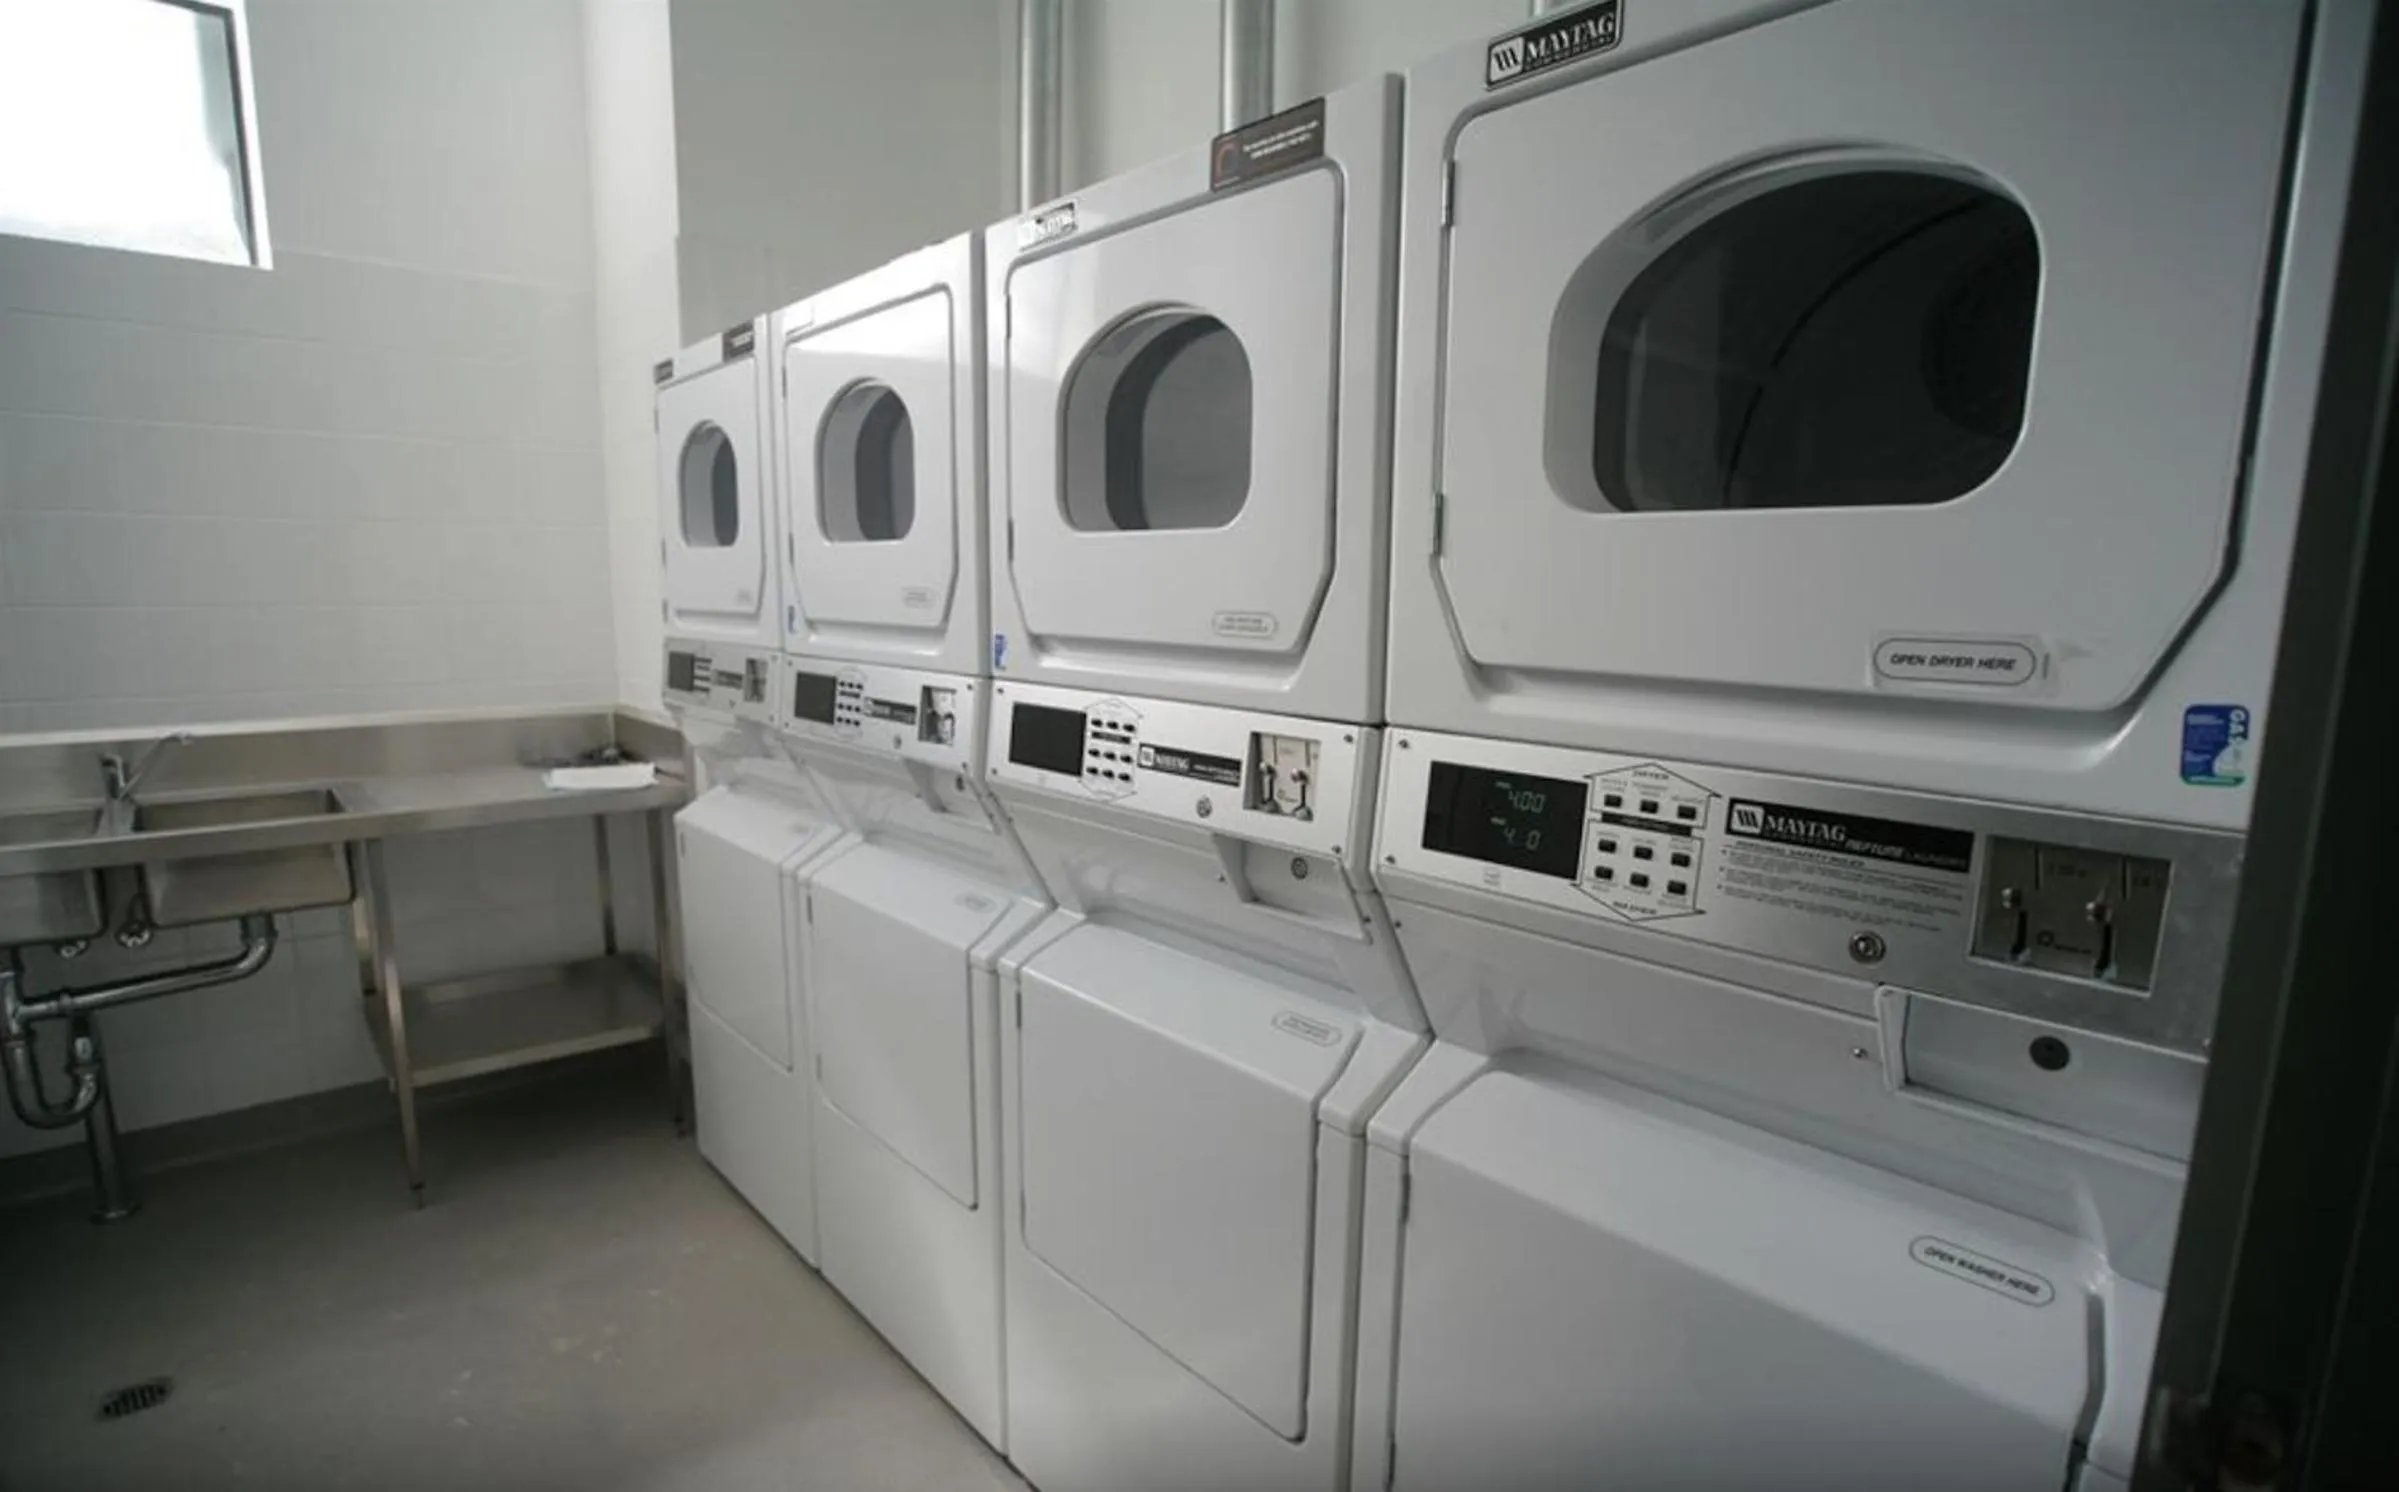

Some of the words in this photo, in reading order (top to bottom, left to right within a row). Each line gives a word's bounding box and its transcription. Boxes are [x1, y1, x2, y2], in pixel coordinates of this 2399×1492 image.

[1526, 12, 1614, 59] MAYTAG
[1890, 652, 1926, 667] OPEN
[1929, 654, 1974, 669] DRYER
[1976, 656, 2017, 671] HERE
[1764, 815, 1847, 842] MAYTAG
[1924, 1246, 1956, 1263] OPEN
[1957, 1258, 2006, 1282] WASHER
[2006, 1277, 2040, 1295] HERE
